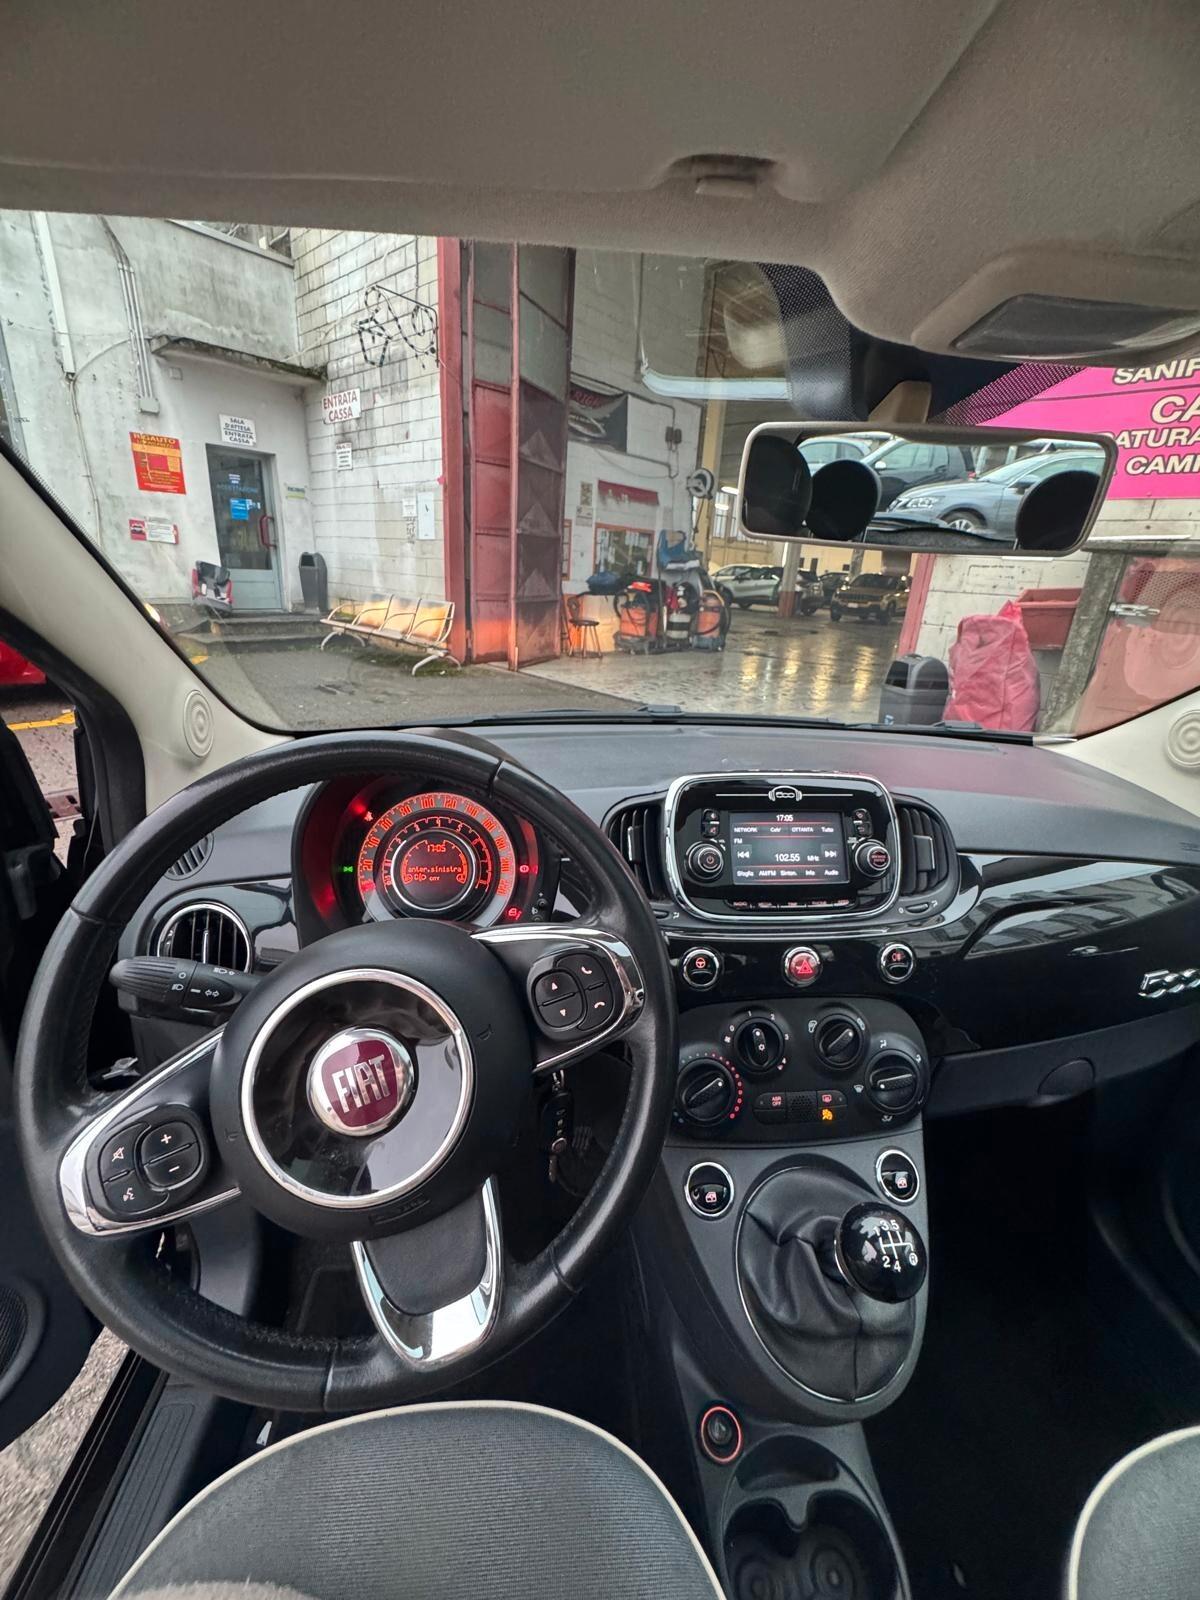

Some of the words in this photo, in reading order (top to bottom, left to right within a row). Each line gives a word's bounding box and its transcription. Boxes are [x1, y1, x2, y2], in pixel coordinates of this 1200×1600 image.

[322, 390, 358, 409] ENTRATA
[328, 406, 353, 422] CASSA
[230, 417, 245, 425] SALA
[224, 430, 254, 440] ENTRATA
[229, 436, 250, 444] CASSA
[1096, 427, 1200, 449] ATURA
[421, 797, 435, 809] 100
[444, 798, 457, 810] 120
[776, 813, 794, 822] 17:05
[427, 844, 446, 853] 17:05
[774, 853, 801, 862] 102.55
[770, 1013, 775, 1021] 2
[331, 1054, 391, 1114] FIAT
[880, 1220, 890, 1231] 3
[890, 1219, 900, 1230] 5
[881, 1255, 891, 1268] 2
[893, 1260, 902, 1272] 4
